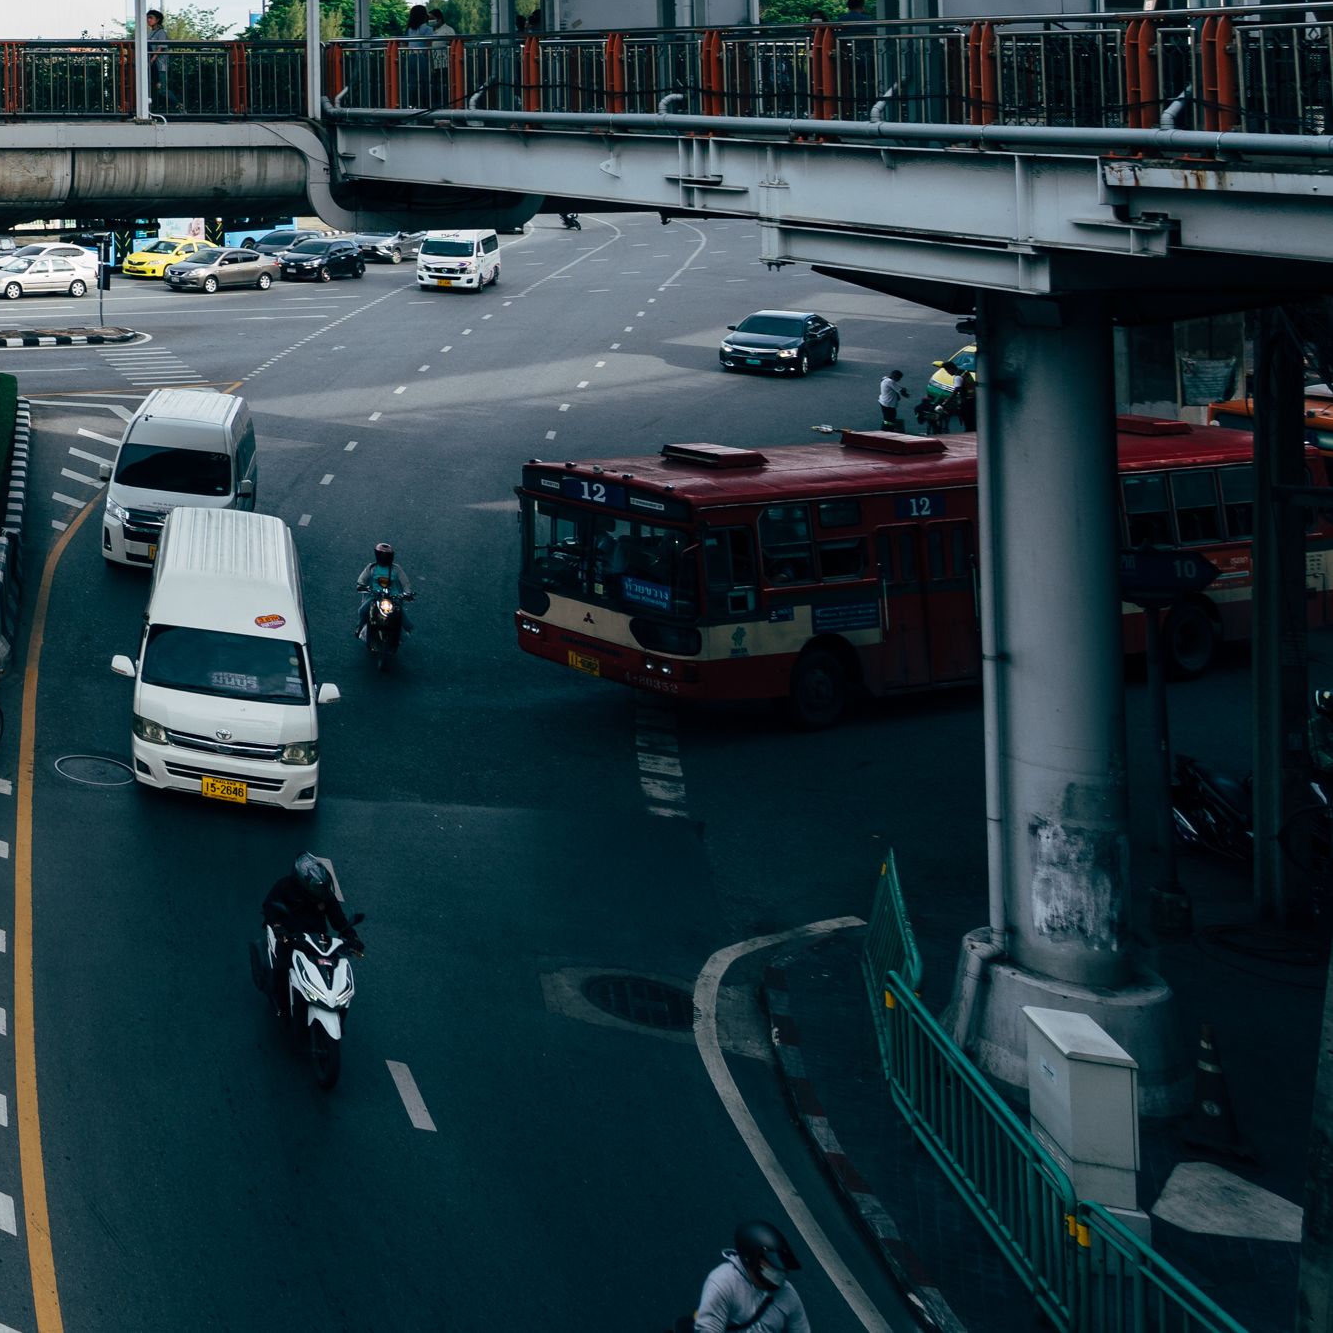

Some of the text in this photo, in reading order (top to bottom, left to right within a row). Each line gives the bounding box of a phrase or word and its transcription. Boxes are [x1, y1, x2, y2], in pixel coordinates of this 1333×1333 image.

[580, 481, 606, 503] 12
[909, 497, 932, 517] 12
[1173, 559, 1197, 579] 10
[206, 781, 245, 797] 15-2646
